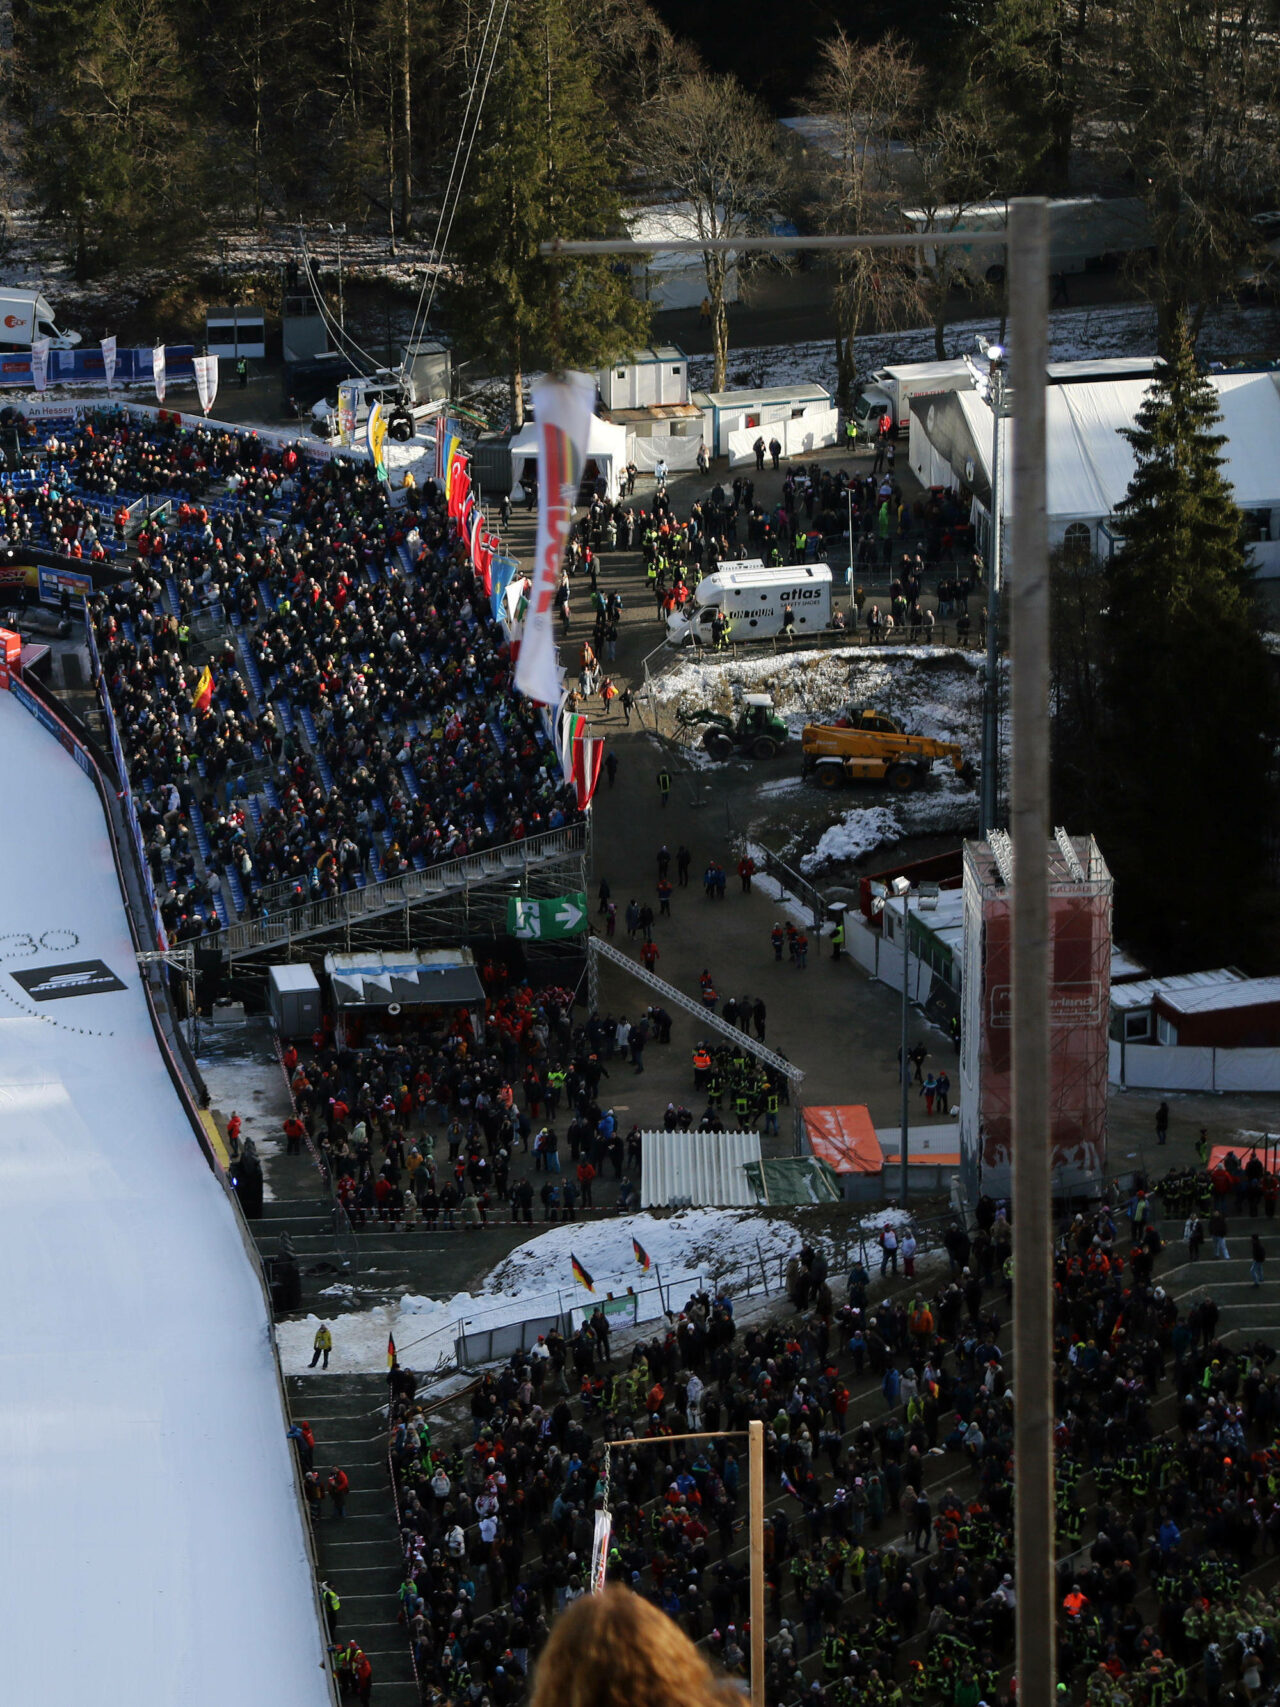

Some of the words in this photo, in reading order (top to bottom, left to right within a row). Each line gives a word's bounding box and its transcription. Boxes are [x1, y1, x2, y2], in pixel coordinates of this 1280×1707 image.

[28, 407, 41, 415] An
[42, 405, 74, 415] Hessen
[780, 588, 821, 601] atlas
